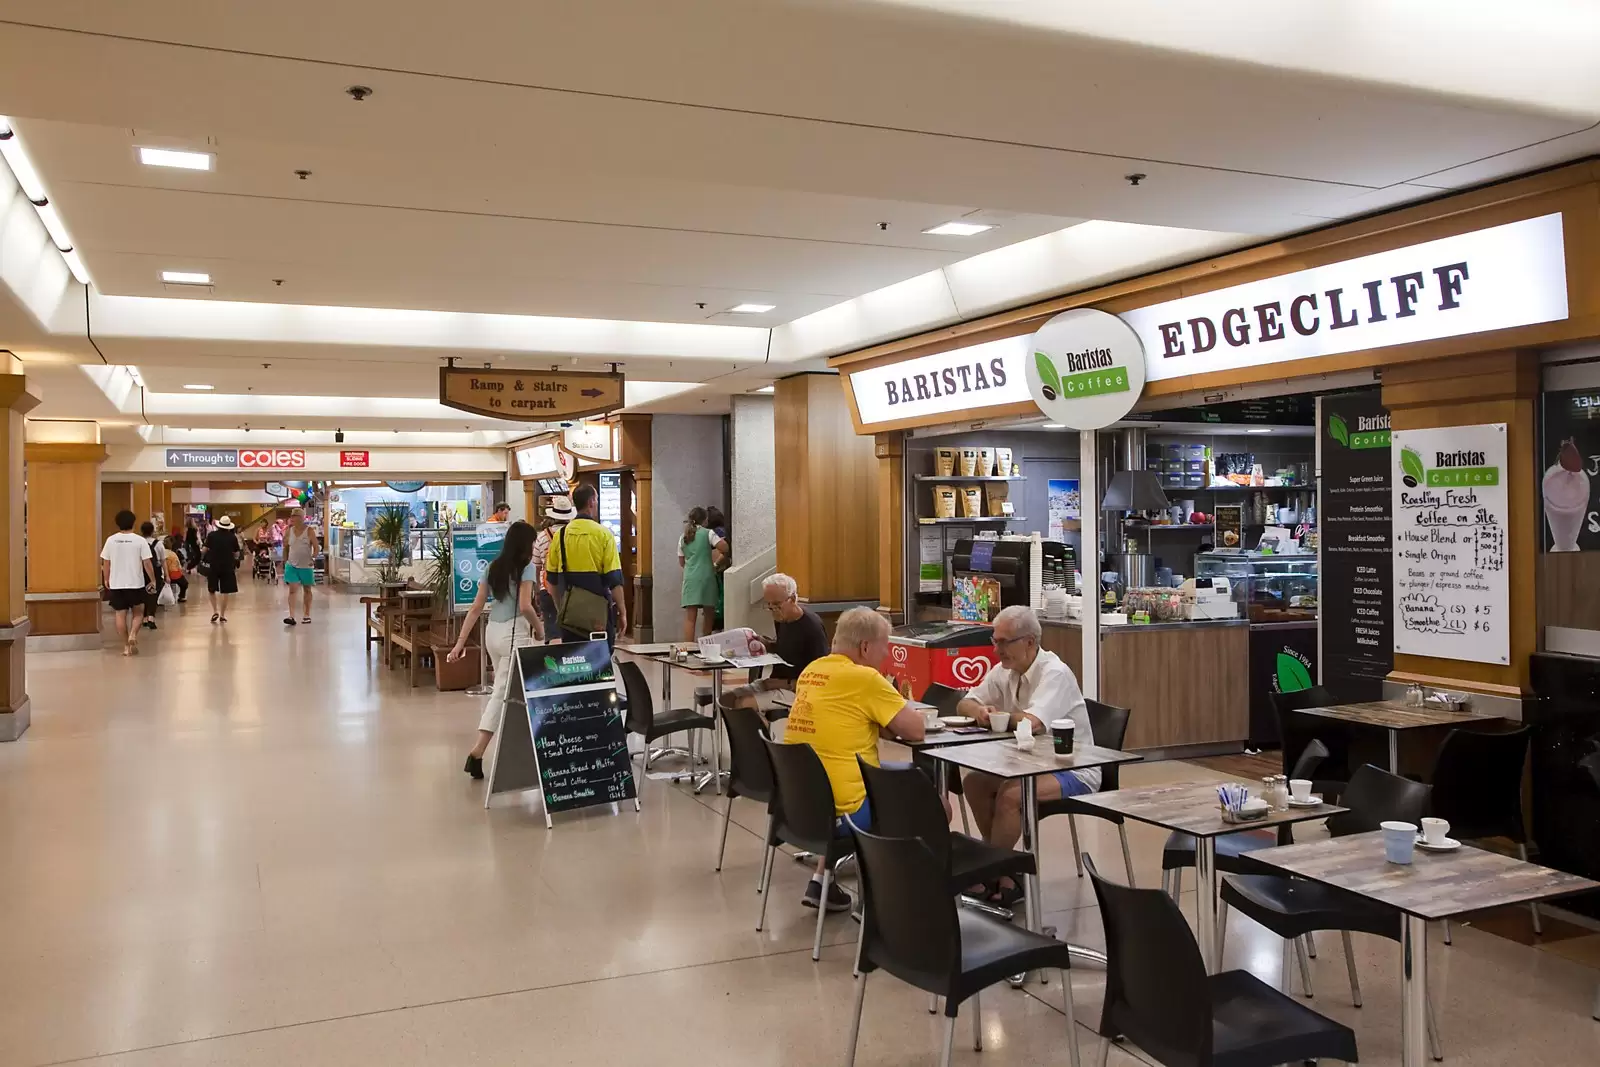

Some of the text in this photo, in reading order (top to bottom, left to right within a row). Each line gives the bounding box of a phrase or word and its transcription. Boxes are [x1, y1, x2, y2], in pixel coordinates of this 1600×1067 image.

[1158, 262, 1470, 359] EDGECLIFF
[1066, 347, 1113, 372] Baristas
[470, 378, 504, 392] Ramp
[514, 379, 524, 391] &
[884, 358, 1007, 406] BARISTAS
[1067, 375, 1122, 392] Coffee
[489, 396, 556, 411] to carpark
[182, 453, 223, 464] Through
[240, 450, 304, 466] coles
[1436, 449, 1485, 468] Baristas
[1432, 472, 1493, 483] Coffee
[1401, 487, 1477, 509] Roasting Fresh
[1404, 530, 1428, 540] House
[1431, 528, 1457, 544] Blend
[1405, 548, 1428, 563] Single
[1431, 549, 1456, 564] Origin
[1440, 570, 1460, 581] ground
[1466, 582, 1490, 591] machine
[1405, 604, 1434, 612] Banana
[1409, 617, 1440, 626] Smoothie
[562, 656, 586, 665] Baristas
[1283, 646, 1312, 668] Since 1984
[560, 734, 583, 745] Cheese
[548, 748, 563, 757] Small
[566, 746, 583, 754] Coffee
[548, 768, 570, 778] Banana
[570, 762, 589, 772] Bread
[554, 779, 567, 788] Small
[570, 777, 587, 786] Coffee
[552, 793, 573, 801] Banana
[573, 788, 595, 798] Smoothie
